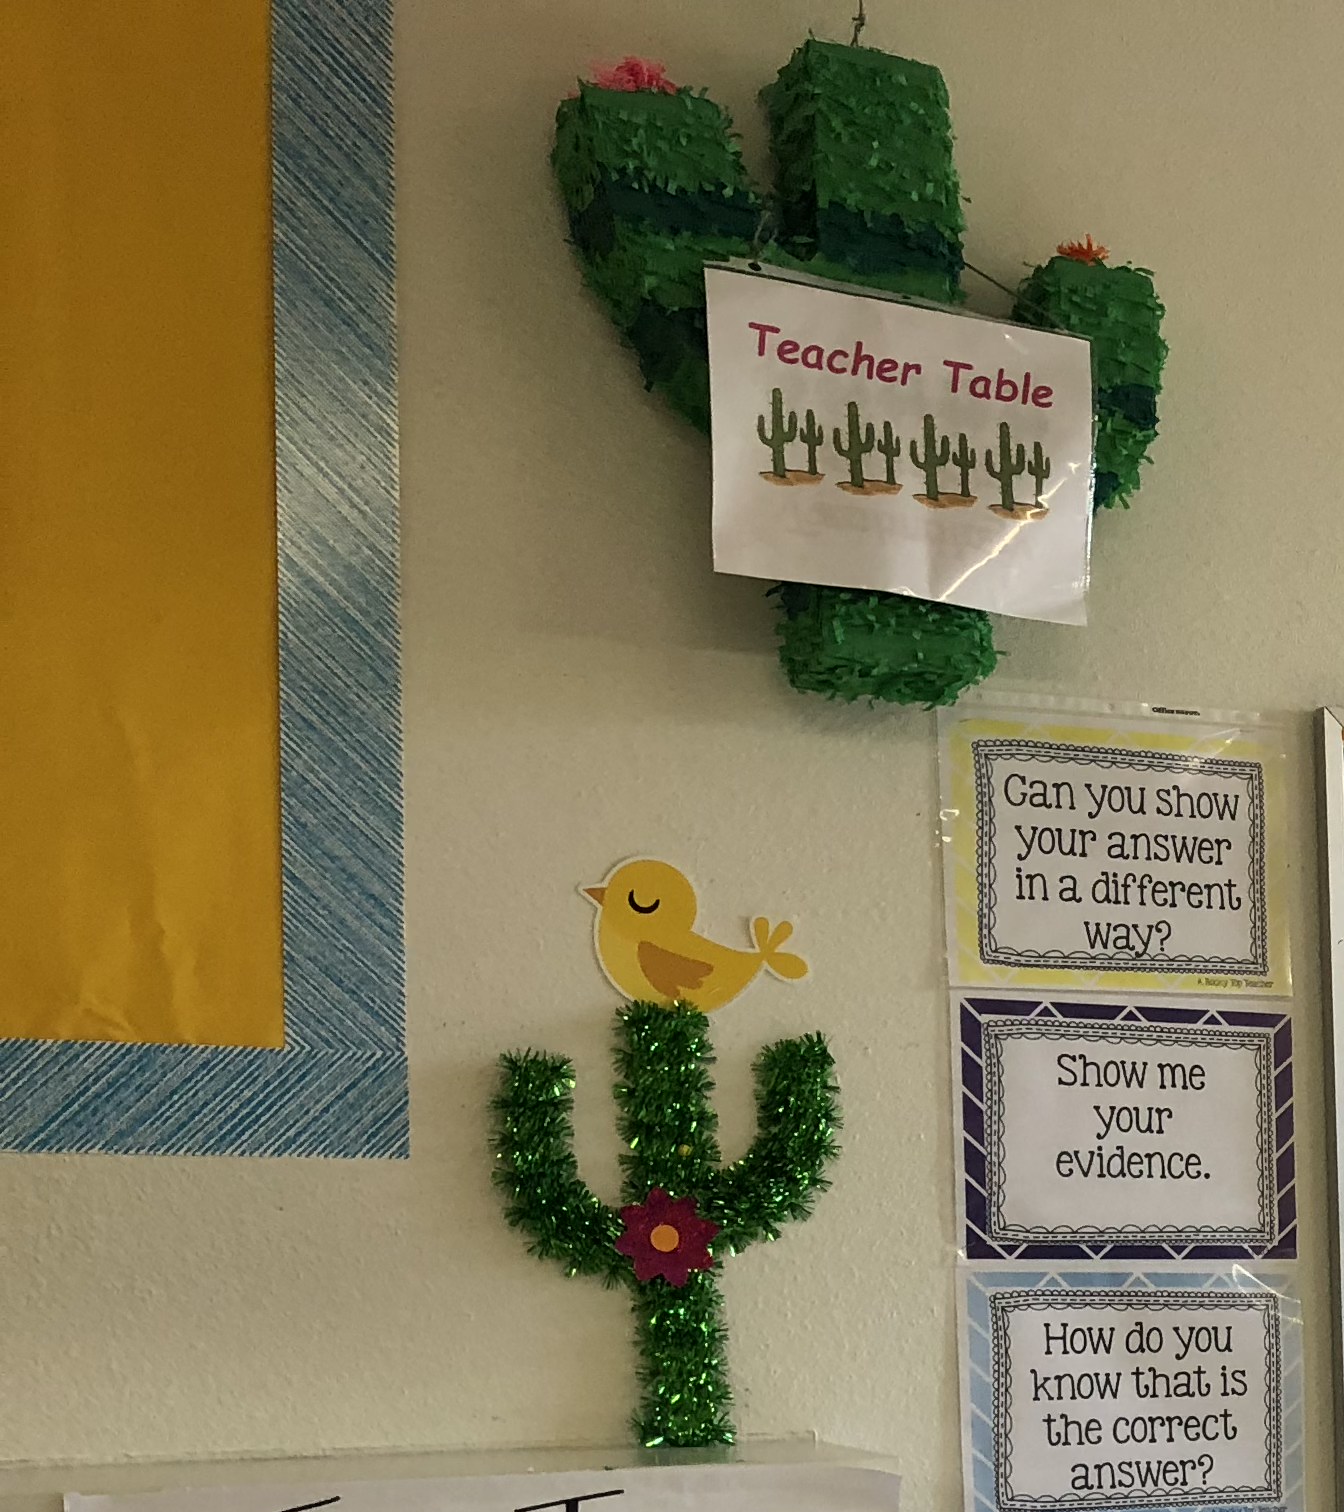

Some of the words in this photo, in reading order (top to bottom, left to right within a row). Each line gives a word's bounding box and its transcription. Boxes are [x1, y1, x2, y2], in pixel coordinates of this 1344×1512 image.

[748, 321, 921, 386] Teacher
[943, 360, 1054, 409] Table
[1004, 774, 1076, 811] Can
[1085, 782, 1147, 819] you
[1156, 785, 1239, 821] show
[1015, 824, 1097, 861] your
[1107, 832, 1232, 866] answer
[1015, 867, 1049, 901] in
[1058, 875, 1083, 904] a
[1091, 871, 1242, 911] different
[1084, 920, 1172, 957] way?
[1057, 1053, 1148, 1089] Show
[1157, 1062, 1206, 1091] me
[1093, 1105, 1173, 1140] your
[1056, 1146, 1211, 1180] evidence.
[1044, 1322, 1115, 1356] How
[1125, 1321, 1163, 1354] do
[1173, 1325, 1233, 1360] you
[1030, 1368, 1122, 1401] know
[1131, 1365, 1211, 1398] that
[1220, 1366, 1248, 1397] is
[1042, 1413, 1103, 1446] the
[1112, 1409, 1237, 1443] correct
[1071, 1453, 1214, 1490] answer?
